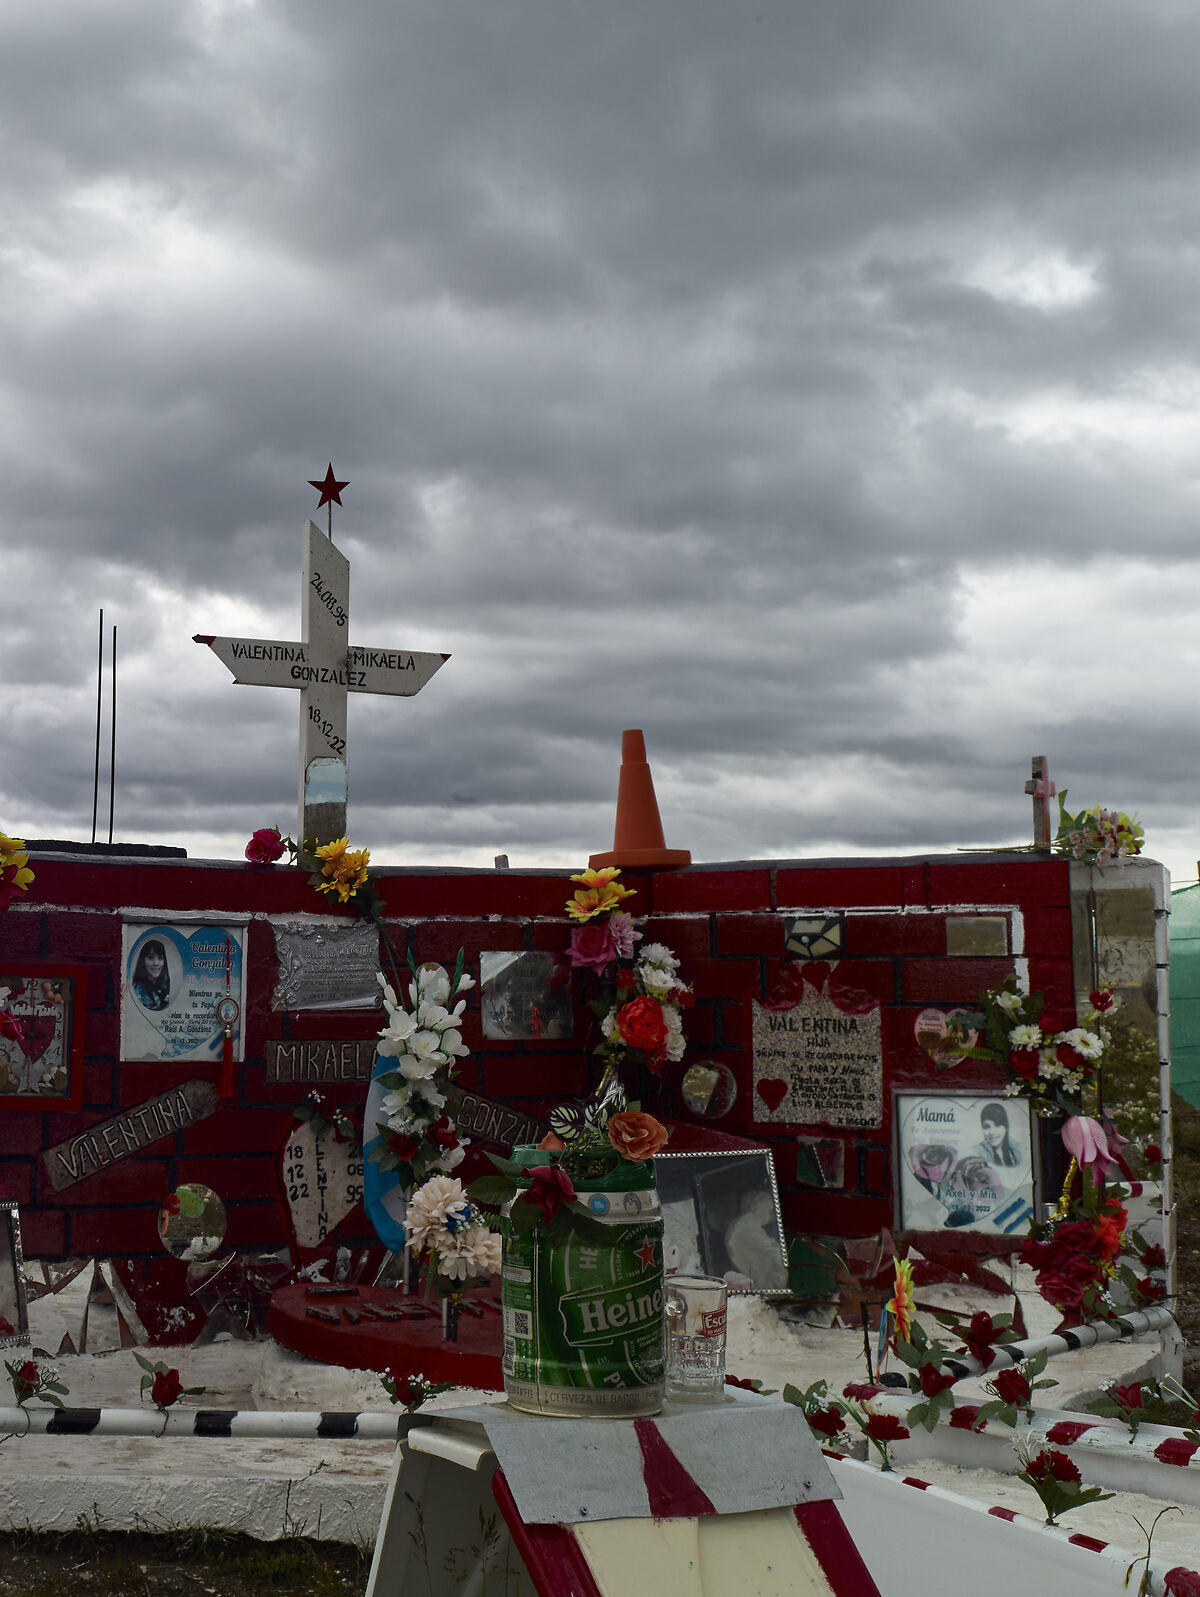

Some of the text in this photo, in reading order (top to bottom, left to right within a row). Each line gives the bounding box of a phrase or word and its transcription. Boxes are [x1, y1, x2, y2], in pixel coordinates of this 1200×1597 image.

[310, 572, 348, 627] 24.08.95
[231, 643, 416, 671] VALENTINA MIKAELA
[290, 665, 367, 687] GONZALEZ
[308, 705, 346, 755] 18.12.22
[190, 942, 236, 954] Valentina
[193, 1011, 219, 1019] recordar
[769, 1016, 860, 1033] VALENTINA
[806, 1037, 831, 1047] HIJA
[917, 1107, 956, 1122] Mamá
[55, 1089, 193, 1178] VALENTINA
[286, 1145, 303, 1160] 18
[289, 1183, 309, 1202] 22
[315, 1136, 328, 1240] LENTINA
[945, 1188, 966, 1198] Axel
[970, 1191, 975, 1200] y
[550, 1391, 593, 1404] CERVEZA
[596, 1394, 608, 1404] DE
